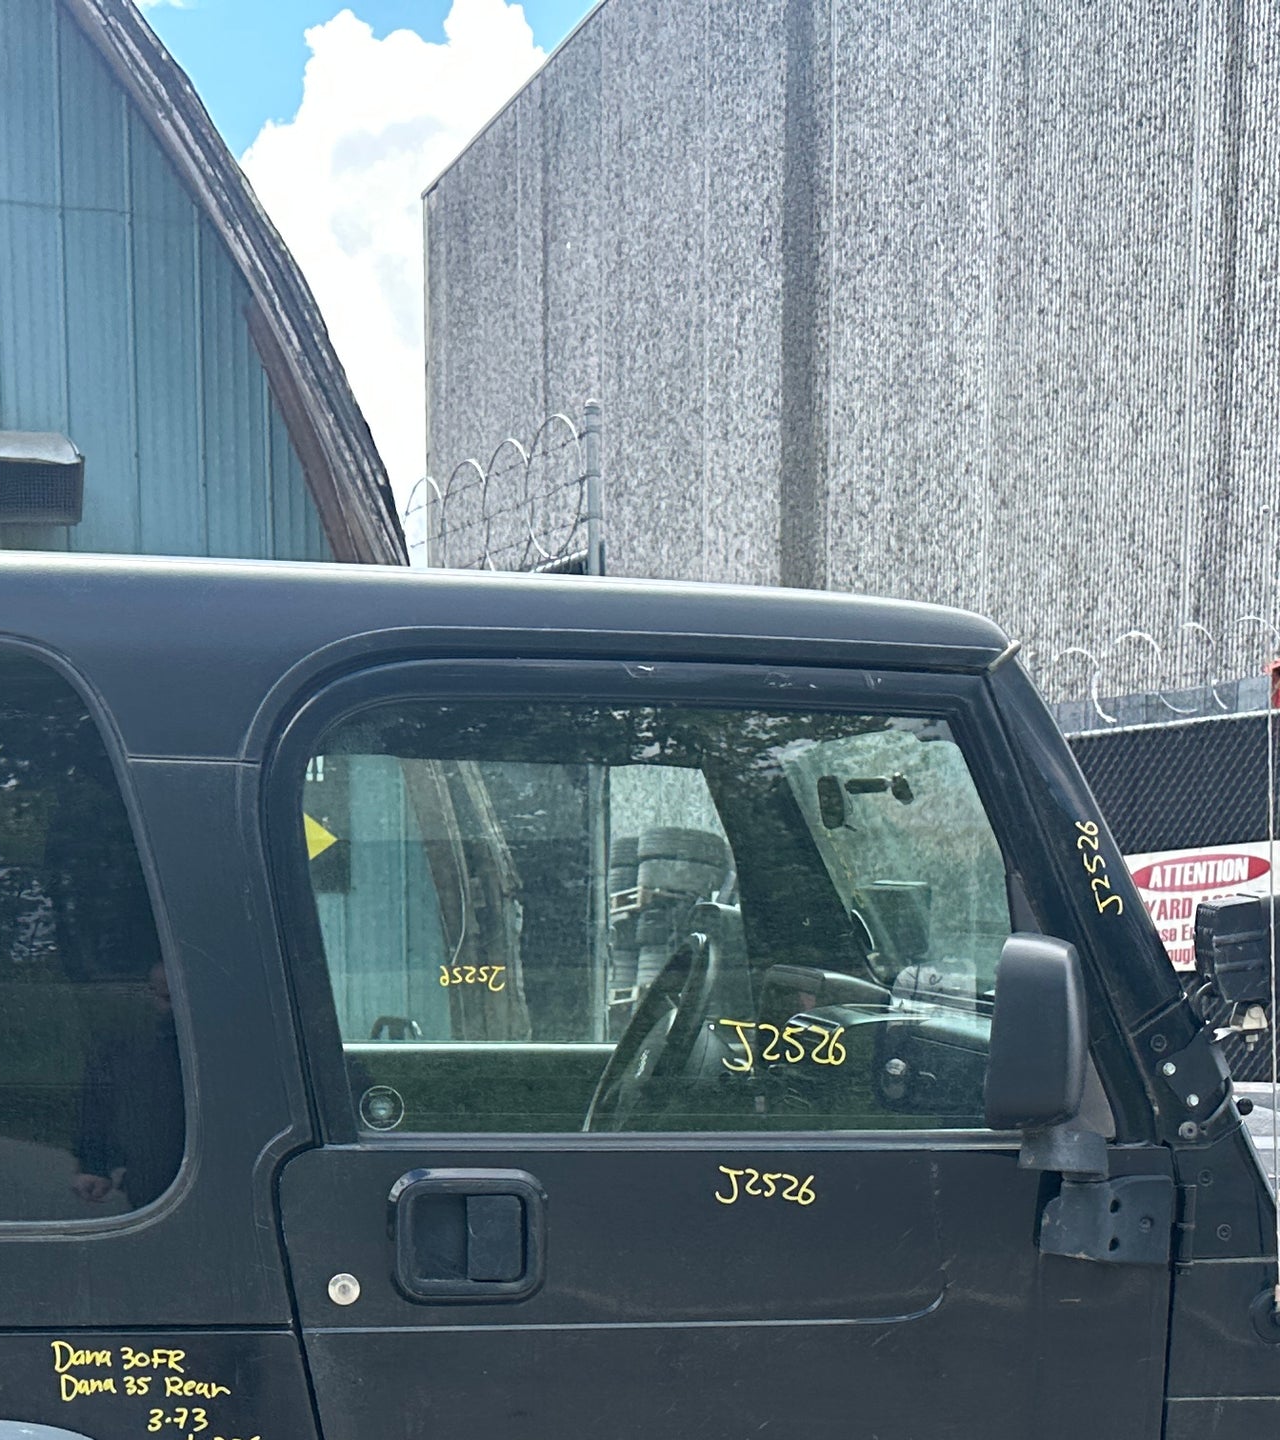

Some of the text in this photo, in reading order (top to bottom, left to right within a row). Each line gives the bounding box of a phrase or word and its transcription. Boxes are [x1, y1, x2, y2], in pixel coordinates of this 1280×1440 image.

[1075, 820, 1123, 916] J2526
[1149, 857, 1250, 889] ATTENTION
[719, 1018, 847, 1072] J2526
[715, 1164, 816, 1206] J2526
[51, 1340, 113, 1373] Dana
[60, 1374, 231, 1402] Dana 35 Rear
